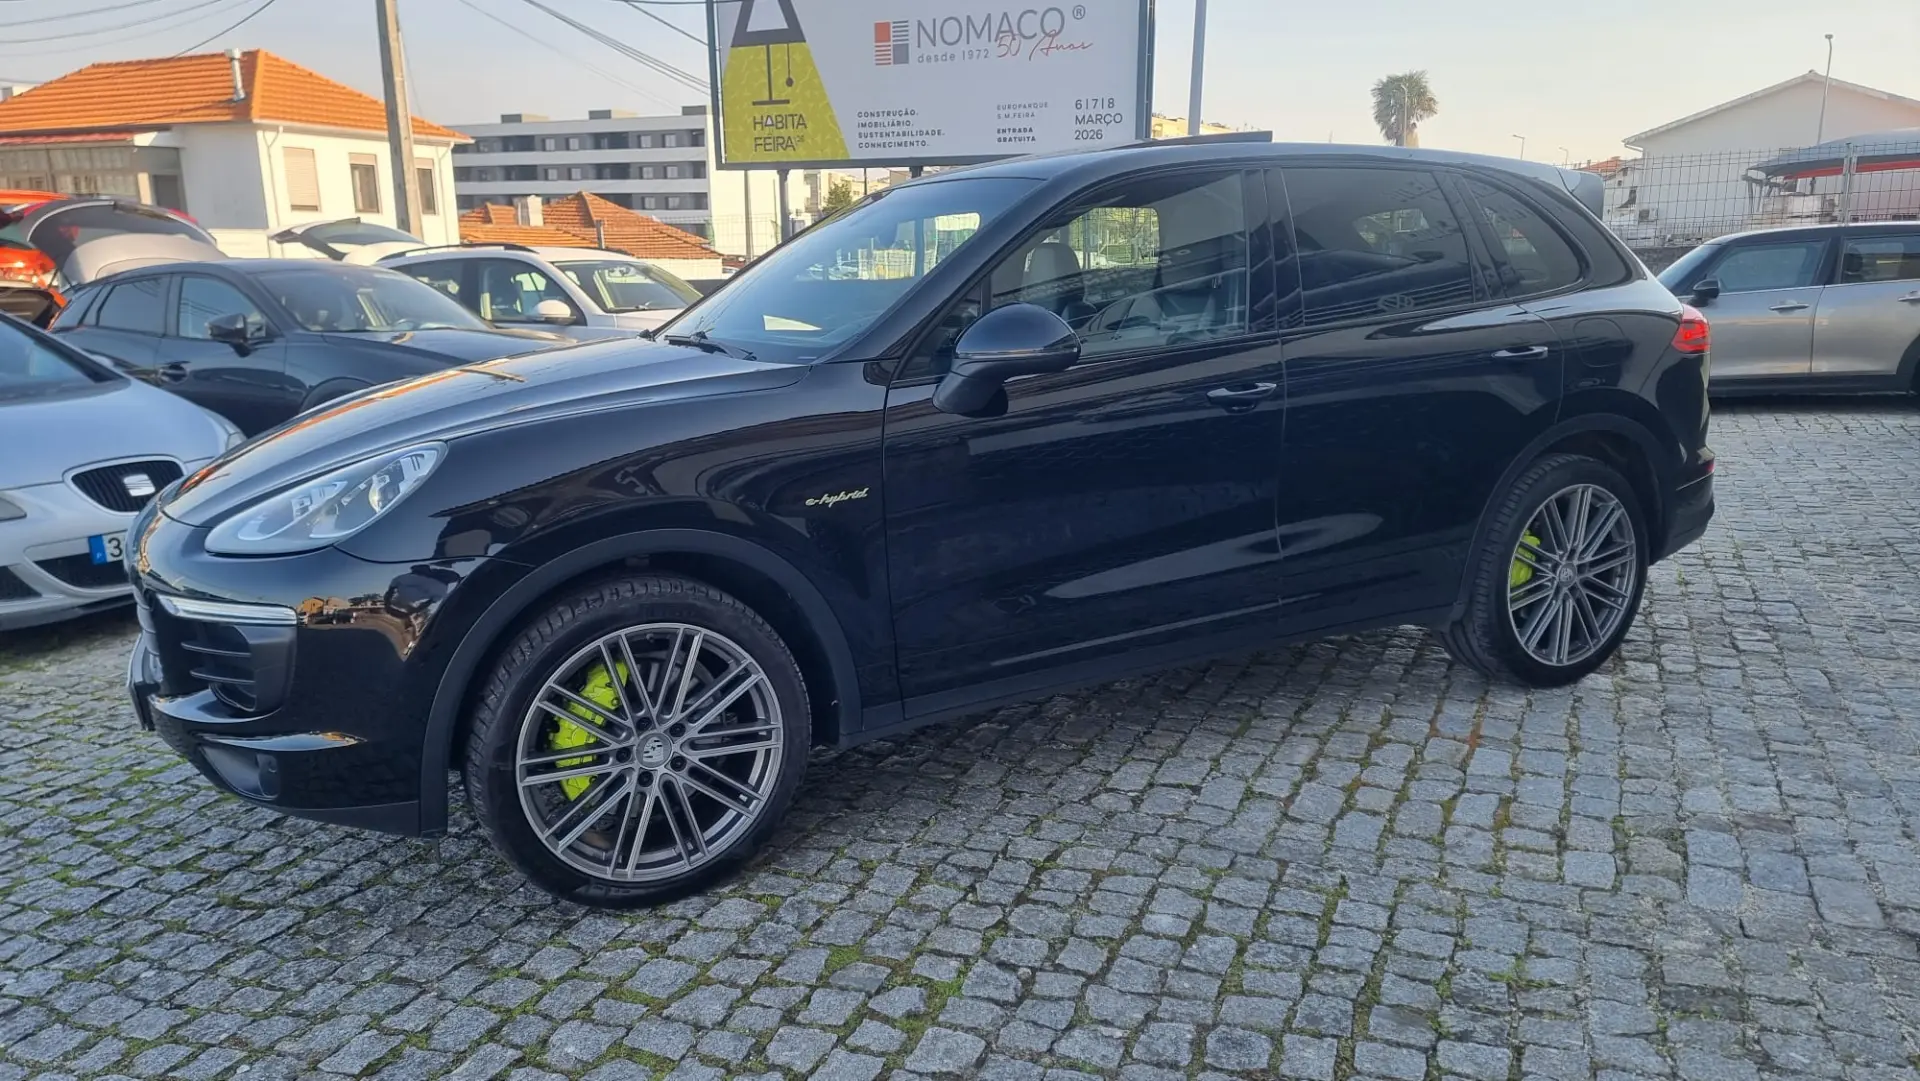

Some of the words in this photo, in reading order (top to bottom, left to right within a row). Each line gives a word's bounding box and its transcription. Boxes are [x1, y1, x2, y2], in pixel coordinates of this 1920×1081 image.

[916, 7, 1065, 48] NOMACO
[997, 33, 1022, 58] 50
[917, 52, 956, 64] desde
[962, 48, 990, 61] 1972
[997, 101, 1049, 111] EUROPARQUE
[753, 113, 808, 131] HABITA
[1075, 112, 1123, 126] MARÇO
[997, 126, 1034, 134] ENTRADA
[1075, 128, 1104, 141] 2026
[997, 135, 1037, 143] GRATUITA
